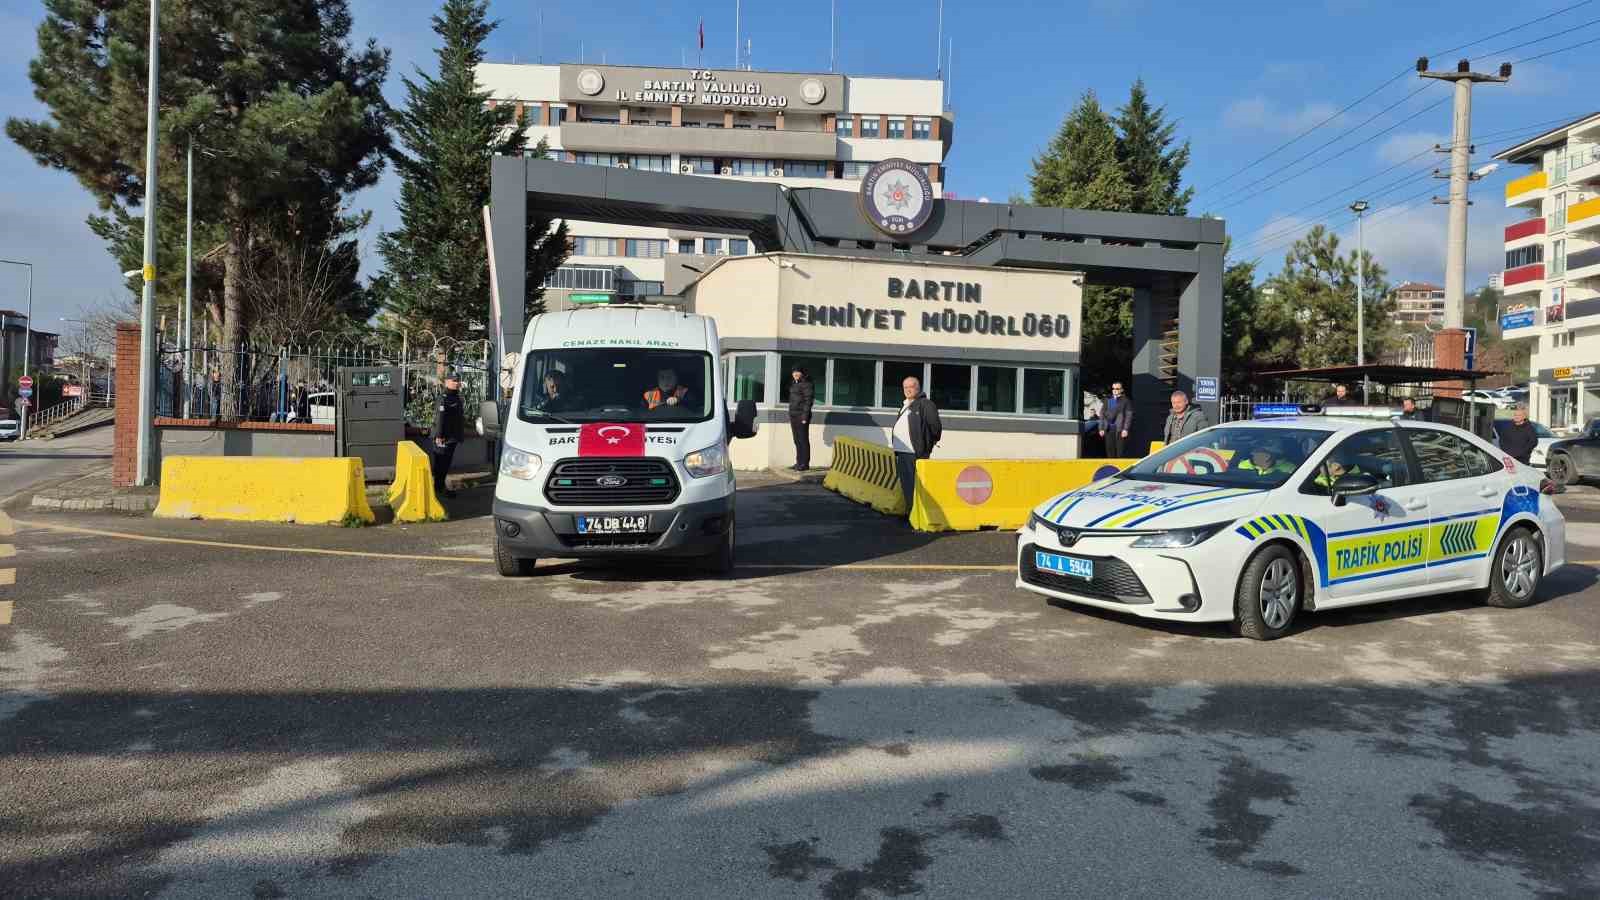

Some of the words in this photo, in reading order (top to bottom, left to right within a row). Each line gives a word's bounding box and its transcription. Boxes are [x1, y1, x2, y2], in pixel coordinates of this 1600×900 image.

[690, 70, 716, 80] T.C.
[644, 80, 695, 92] BARTIN
[634, 90, 696, 104] EMNİYET
[701, 93, 787, 107] MÜDÜRLÜĞÜ
[887, 277, 982, 304] BARTIN
[791, 302, 906, 331] EMNİYET
[921, 308, 1071, 339] MÜDÜRLÜĞÜ
[562, 339, 606, 347] CENAZE
[586, 518, 602, 531] 74
[1336, 541, 1381, 570] TRAFİK
[1383, 533, 1423, 562] POLİSİ
[1039, 553, 1051, 567] 74
[1057, 560, 1063, 570] A
[1069, 560, 1092, 576] 5944
